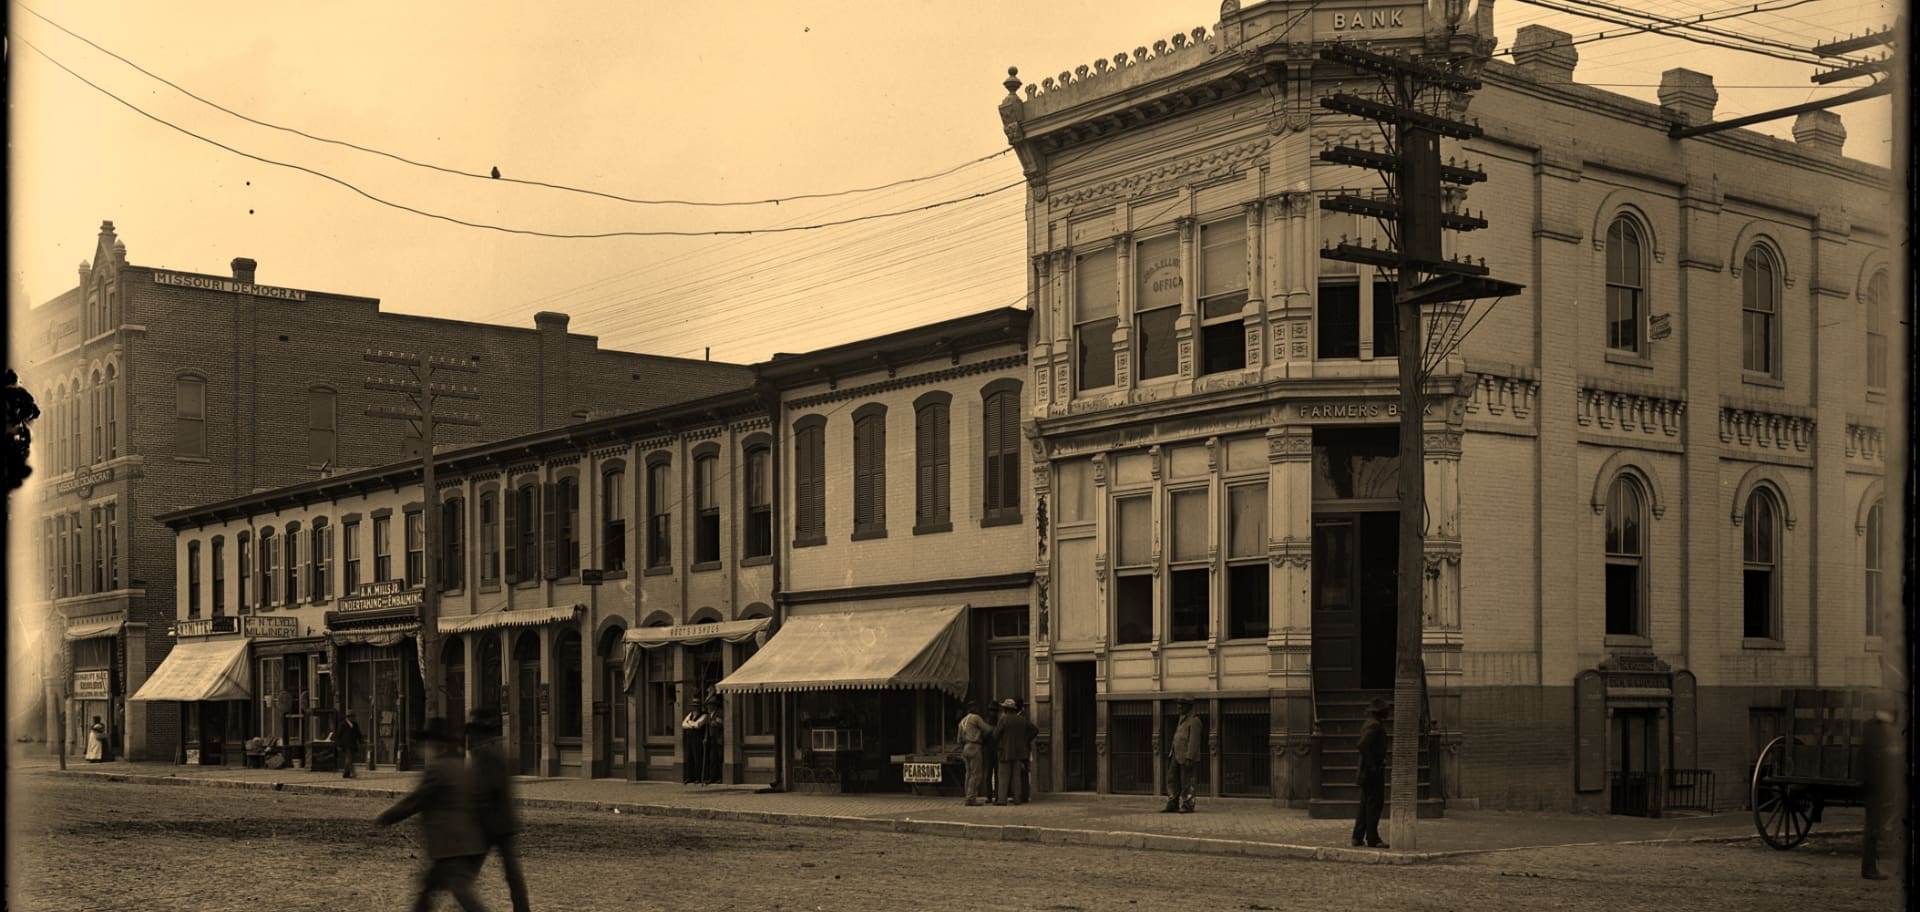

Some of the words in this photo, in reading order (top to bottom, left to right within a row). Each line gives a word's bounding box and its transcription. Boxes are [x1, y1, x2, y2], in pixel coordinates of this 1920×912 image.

[1334, 9, 1404, 29] BANK
[157, 272, 226, 290] MISSOURI
[232, 281, 306, 300] DEMOCRAT
[1153, 276, 1181, 293] OFFIC
[1299, 403, 1379, 418] FARMERS
[1388, 402, 1433, 417] BK
[374, 584, 391, 596] MILLS
[340, 597, 382, 611] UNDERTAKING
[388, 592, 423, 607] EMBALMING
[246, 627, 296, 637] MILLINERY
[904, 764, 940, 778] PEARSON'S
